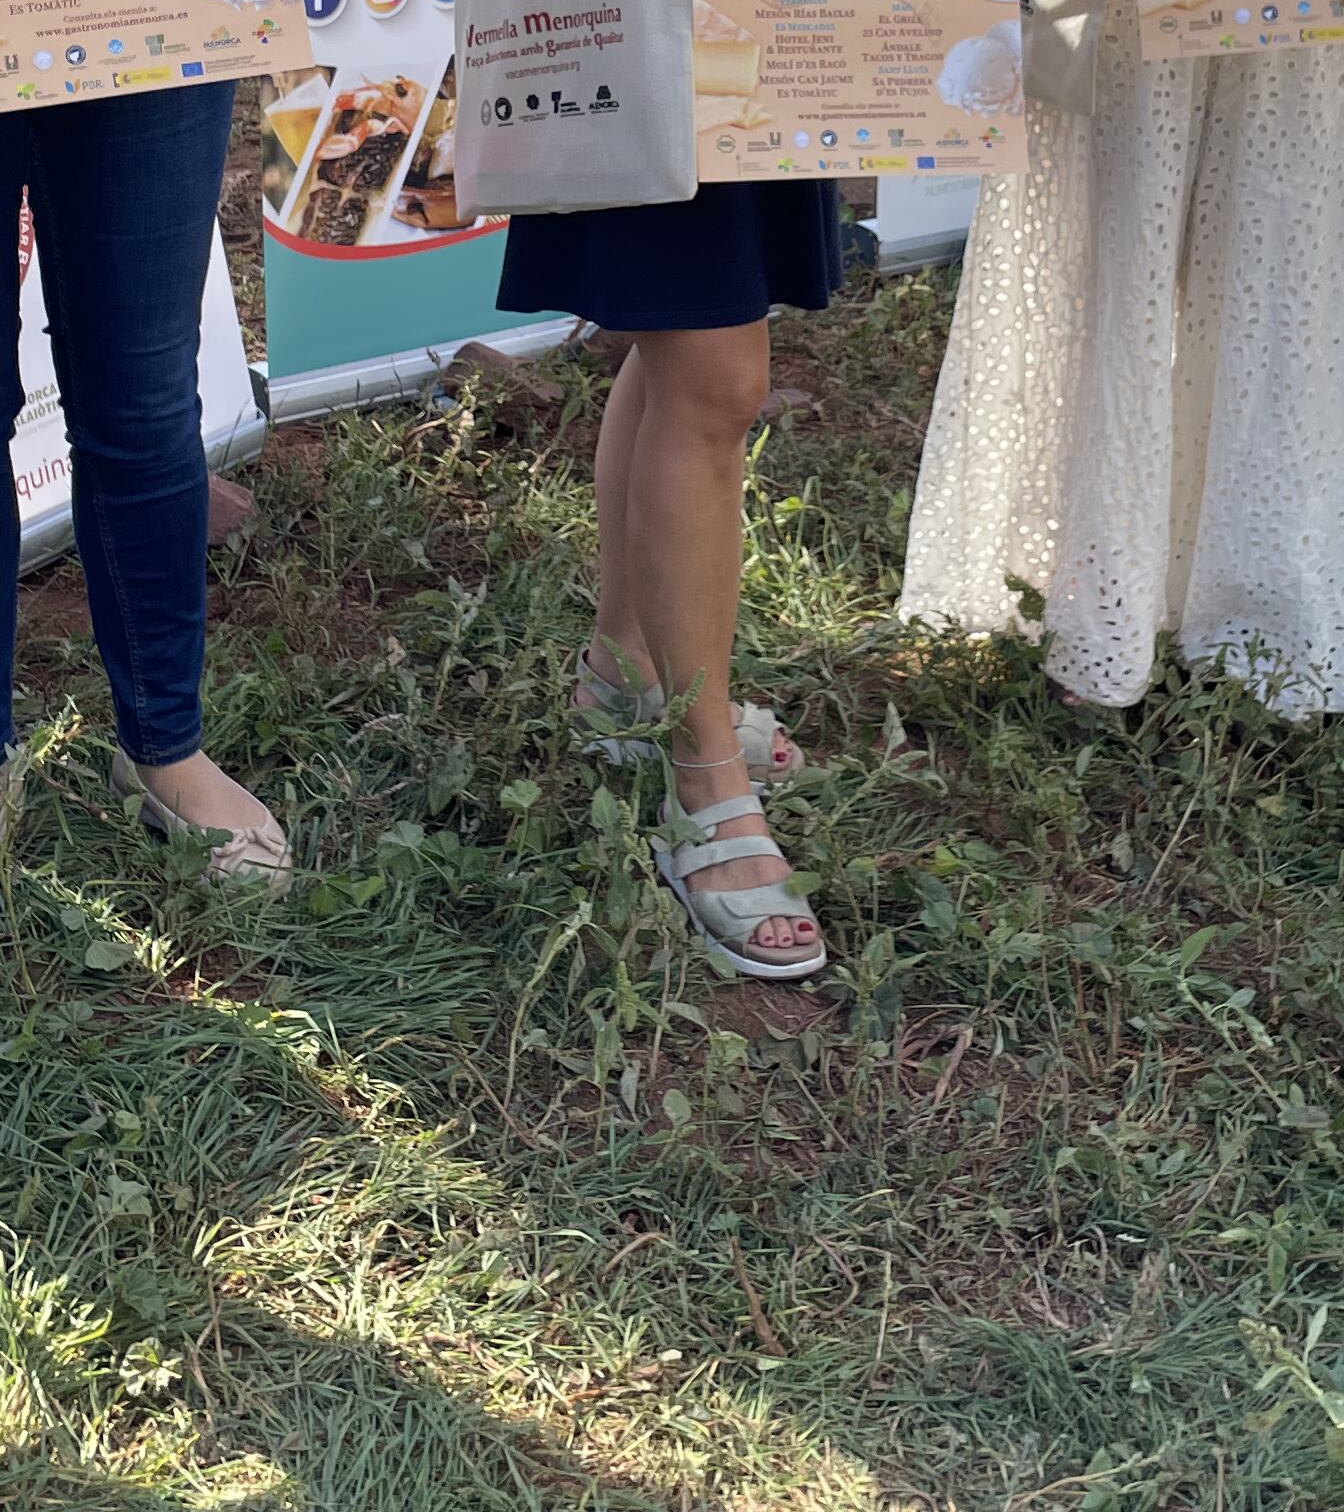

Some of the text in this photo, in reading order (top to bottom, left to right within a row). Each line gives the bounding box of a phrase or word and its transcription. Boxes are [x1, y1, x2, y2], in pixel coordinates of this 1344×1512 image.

[466, 19, 518, 48] Vermella
[520, 44, 544, 57] amb
[27, 382, 57, 405] ORCA
[16, 456, 73, 500] quina
